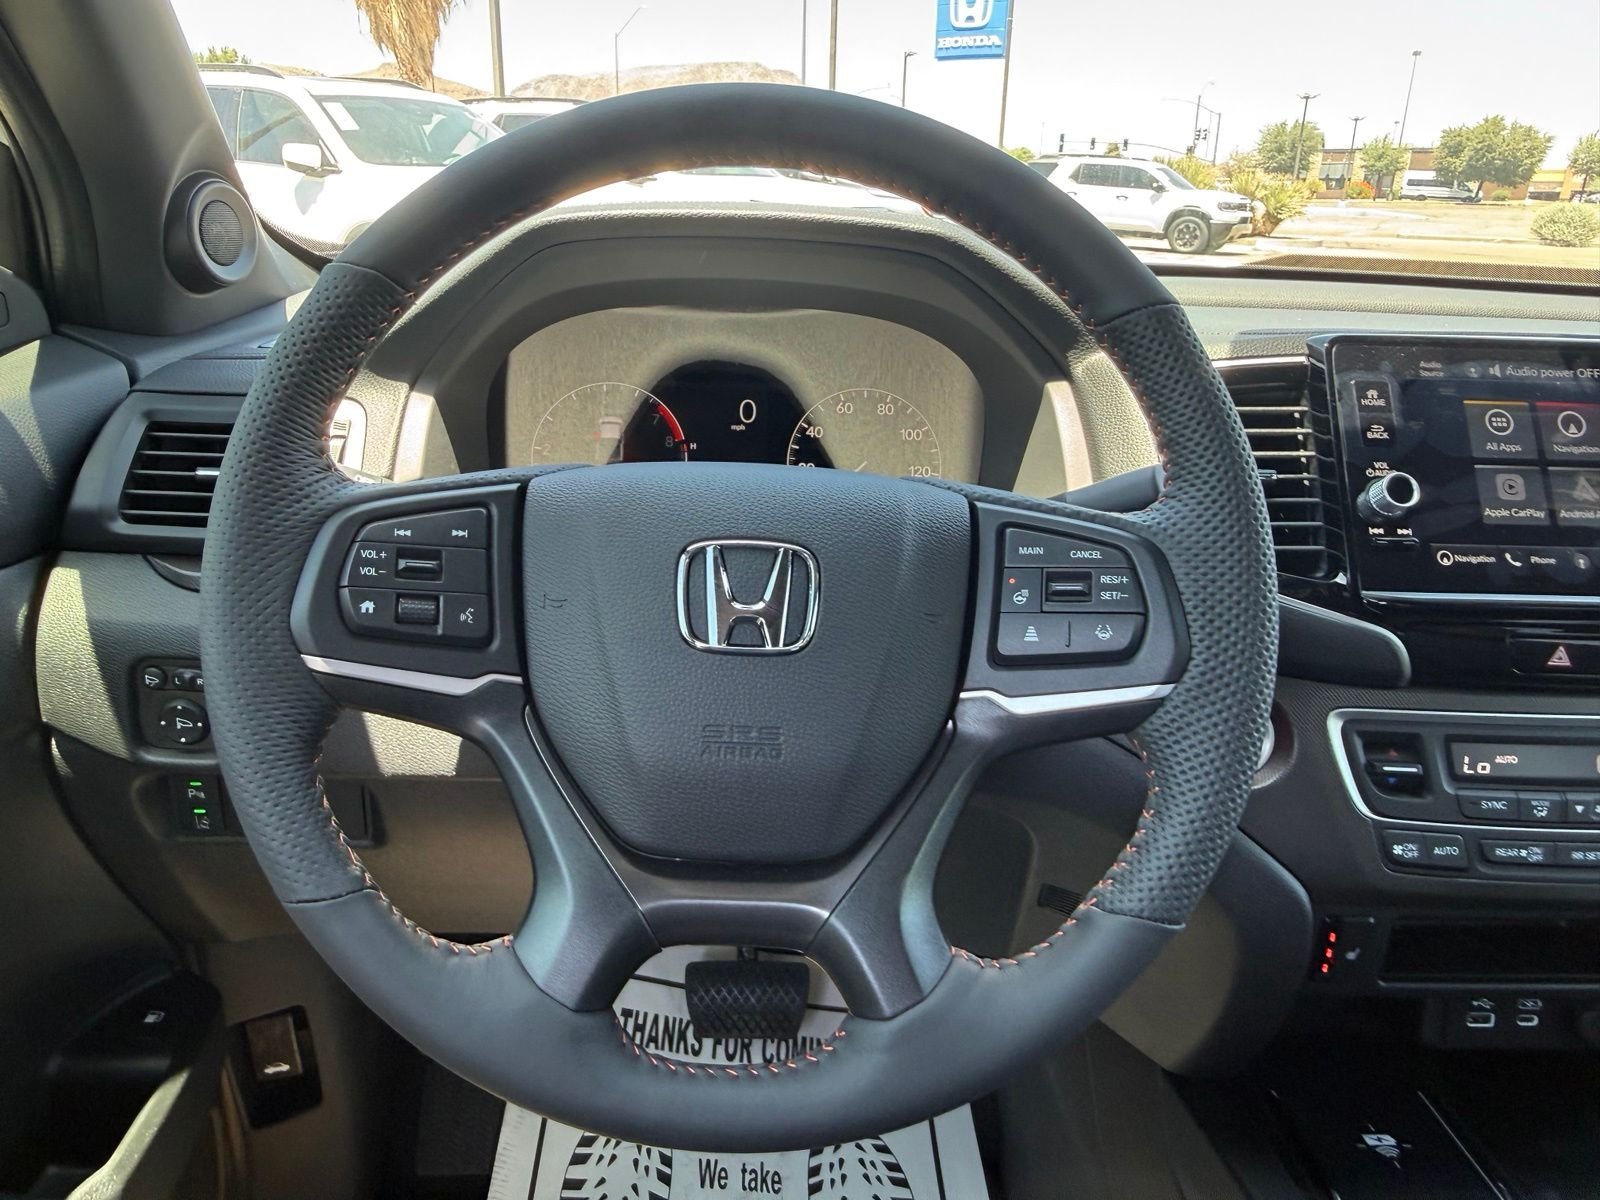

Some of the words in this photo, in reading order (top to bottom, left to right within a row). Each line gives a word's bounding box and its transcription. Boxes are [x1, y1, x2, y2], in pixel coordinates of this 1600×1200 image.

[938, 35, 1003, 49] HONDA
[1506, 365, 1538, 377] Audio
[1541, 369, 1575, 379] power
[1577, 368, 1600, 379] OFF
[1361, 398, 1386, 407] HOME
[739, 399, 757, 423] 0
[836, 402, 854, 415] 60
[877, 403, 894, 415] 80
[731, 424, 746, 432] mph
[805, 426, 824, 439] 40
[900, 429, 923, 441] 100
[1366, 431, 1390, 440] BACK
[690, 442, 697, 450] H
[1486, 442, 1498, 451] All
[1500, 442, 1522, 453] Apps
[1373, 461, 1390, 470] VOL
[908, 465, 932, 478] 120
[1375, 469, 1397, 477] AUD
[1484, 507, 1511, 519] Apple
[1511, 508, 1546, 519] CarPlay
[1018, 546, 1044, 555] MAIN
[1070, 550, 1103, 559] CANCEL
[1454, 554, 1497, 564] Navigation
[1530, 555, 1557, 565] Phone
[702, 724, 783, 740] SRS
[701, 745, 783, 760] AIRBAG
[1494, 755, 1519, 764] AUTO
[1480, 800, 1508, 810] SYNC
[1433, 846, 1460, 856] AUTO
[620, 1007, 703, 1058] THANKS
[711, 1037, 752, 1065] FOR
[698, 1158, 729, 1190] We
[740, 1161, 783, 1195] take
